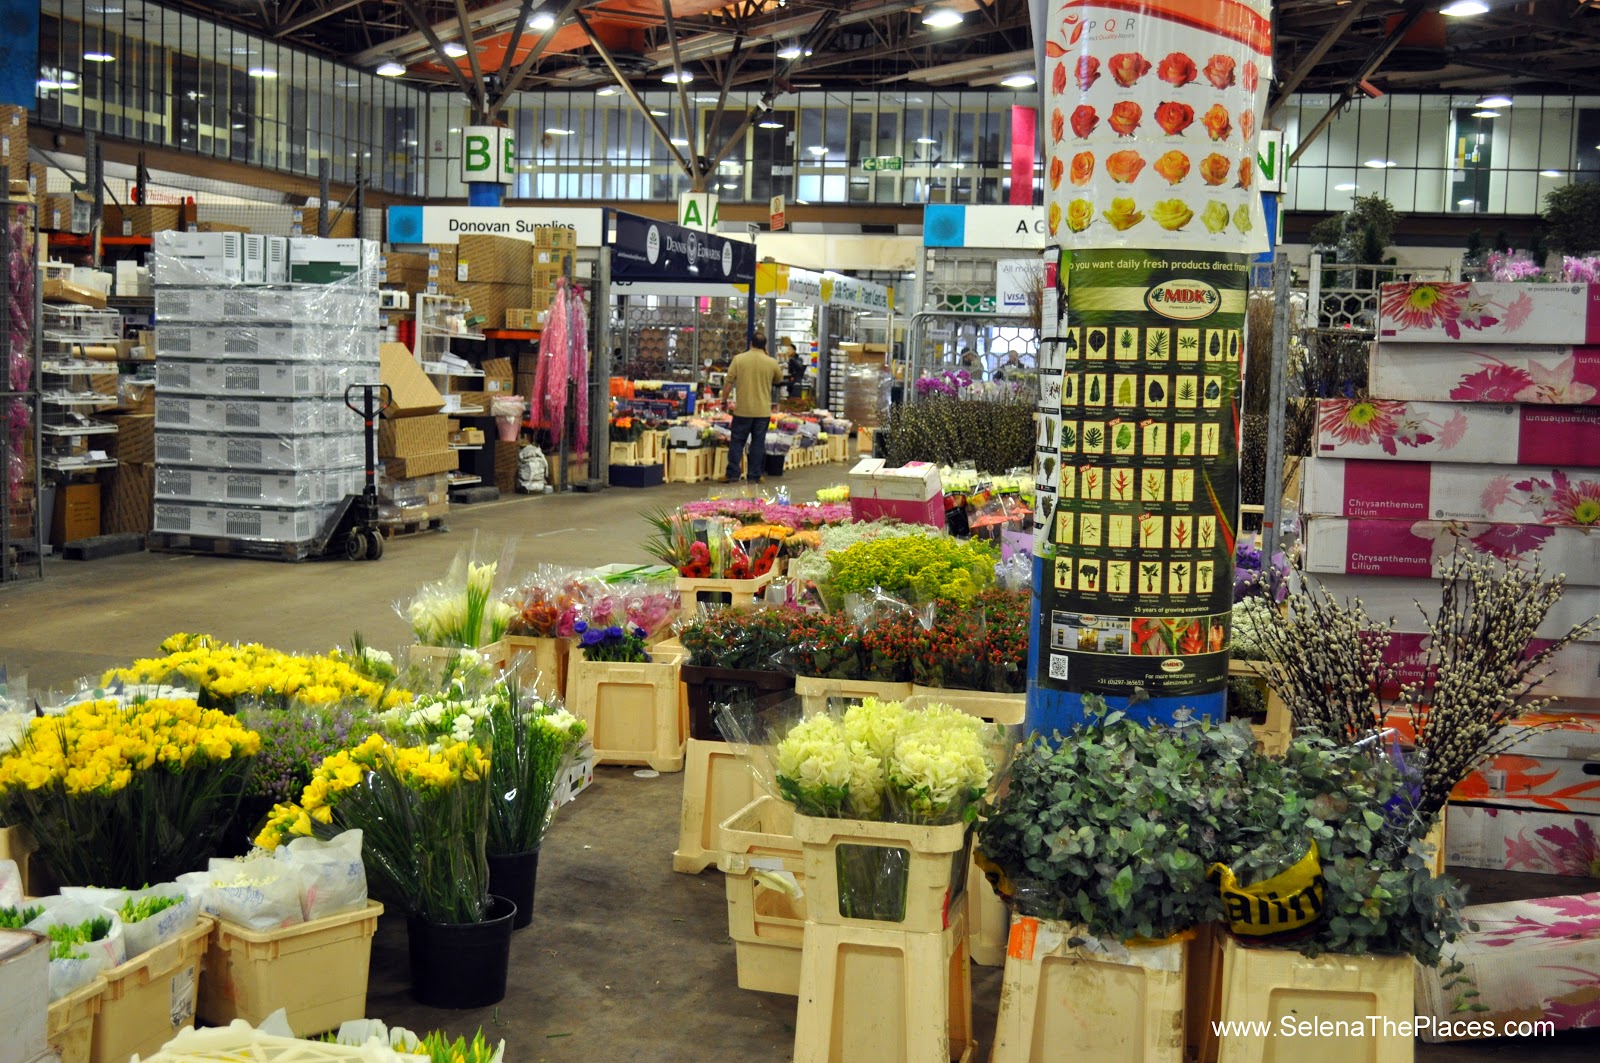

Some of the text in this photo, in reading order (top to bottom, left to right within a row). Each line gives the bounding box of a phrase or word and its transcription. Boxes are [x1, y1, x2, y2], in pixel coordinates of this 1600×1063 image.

[466, 136, 491, 172] B
[683, 200, 702, 226] A
[449, 219, 510, 232] Donovan
[1016, 220, 1028, 234] A
[1075, 261, 1090, 271] you
[1092, 260, 1114, 269] want
[1116, 260, 1140, 271] daily
[1143, 259, 1168, 269] fresh
[1171, 260, 1210, 271] products
[1212, 261, 1233, 271] direct
[1007, 293, 1025, 301] VISA
[1164, 288, 1207, 304] MDK
[1140, 419, 1152, 427] NEW
[1348, 498, 1424, 509] Chrysanthemum
[1138, 513, 1150, 521] NEW
[1348, 508, 1377, 516] Lilium
[1351, 553, 1427, 564] Chrysanthemum
[1351, 562, 1380, 571] Lilium
